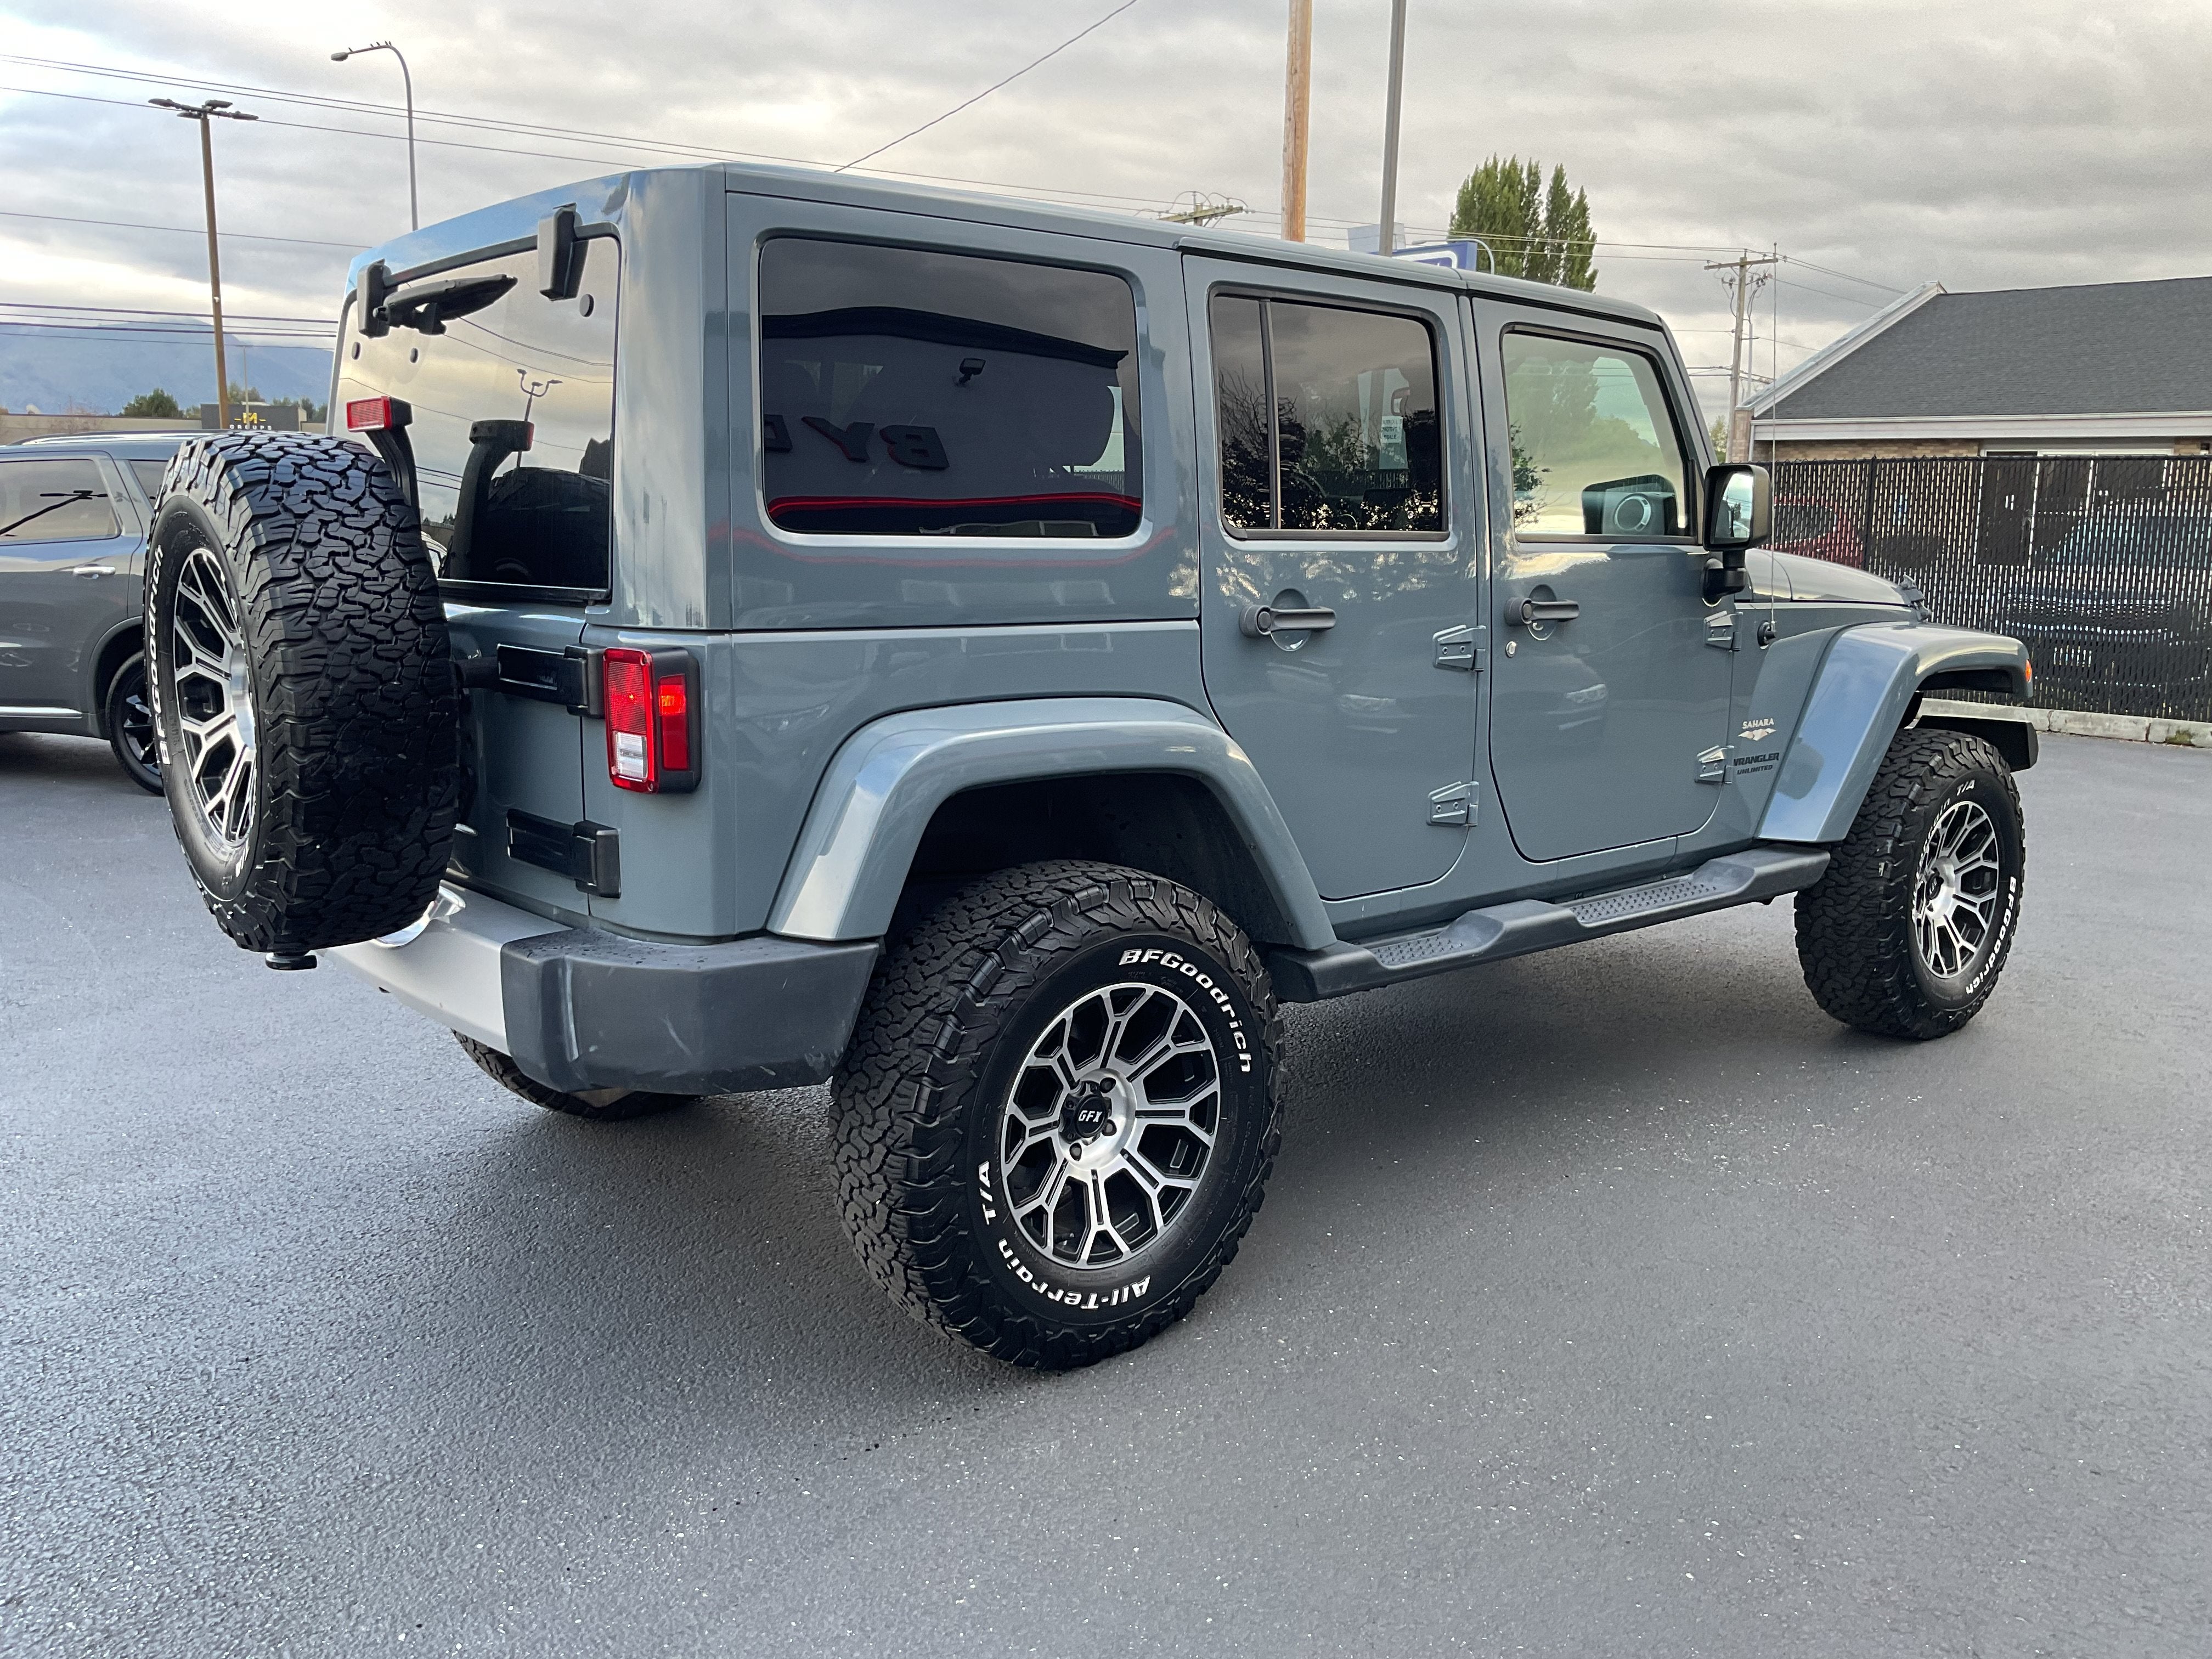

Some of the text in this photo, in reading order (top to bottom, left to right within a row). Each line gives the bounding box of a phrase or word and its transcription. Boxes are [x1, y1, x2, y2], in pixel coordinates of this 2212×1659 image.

[148, 544, 171, 765] BFGoodrich
[1742, 718, 1774, 729] SAHARA
[1733, 752, 1780, 766] WRANGLER
[1737, 764, 1773, 775] UNLIMITED
[1956, 780, 1976, 797] T/A
[1966, 876, 2017, 994] BFGoodrich
[1118, 949, 1251, 1073] BFGoodrich
[1078, 1110, 1103, 1122] GFX
[978, 1160, 997, 1225] T/A
[997, 1238, 1151, 1310] All-Terrain
